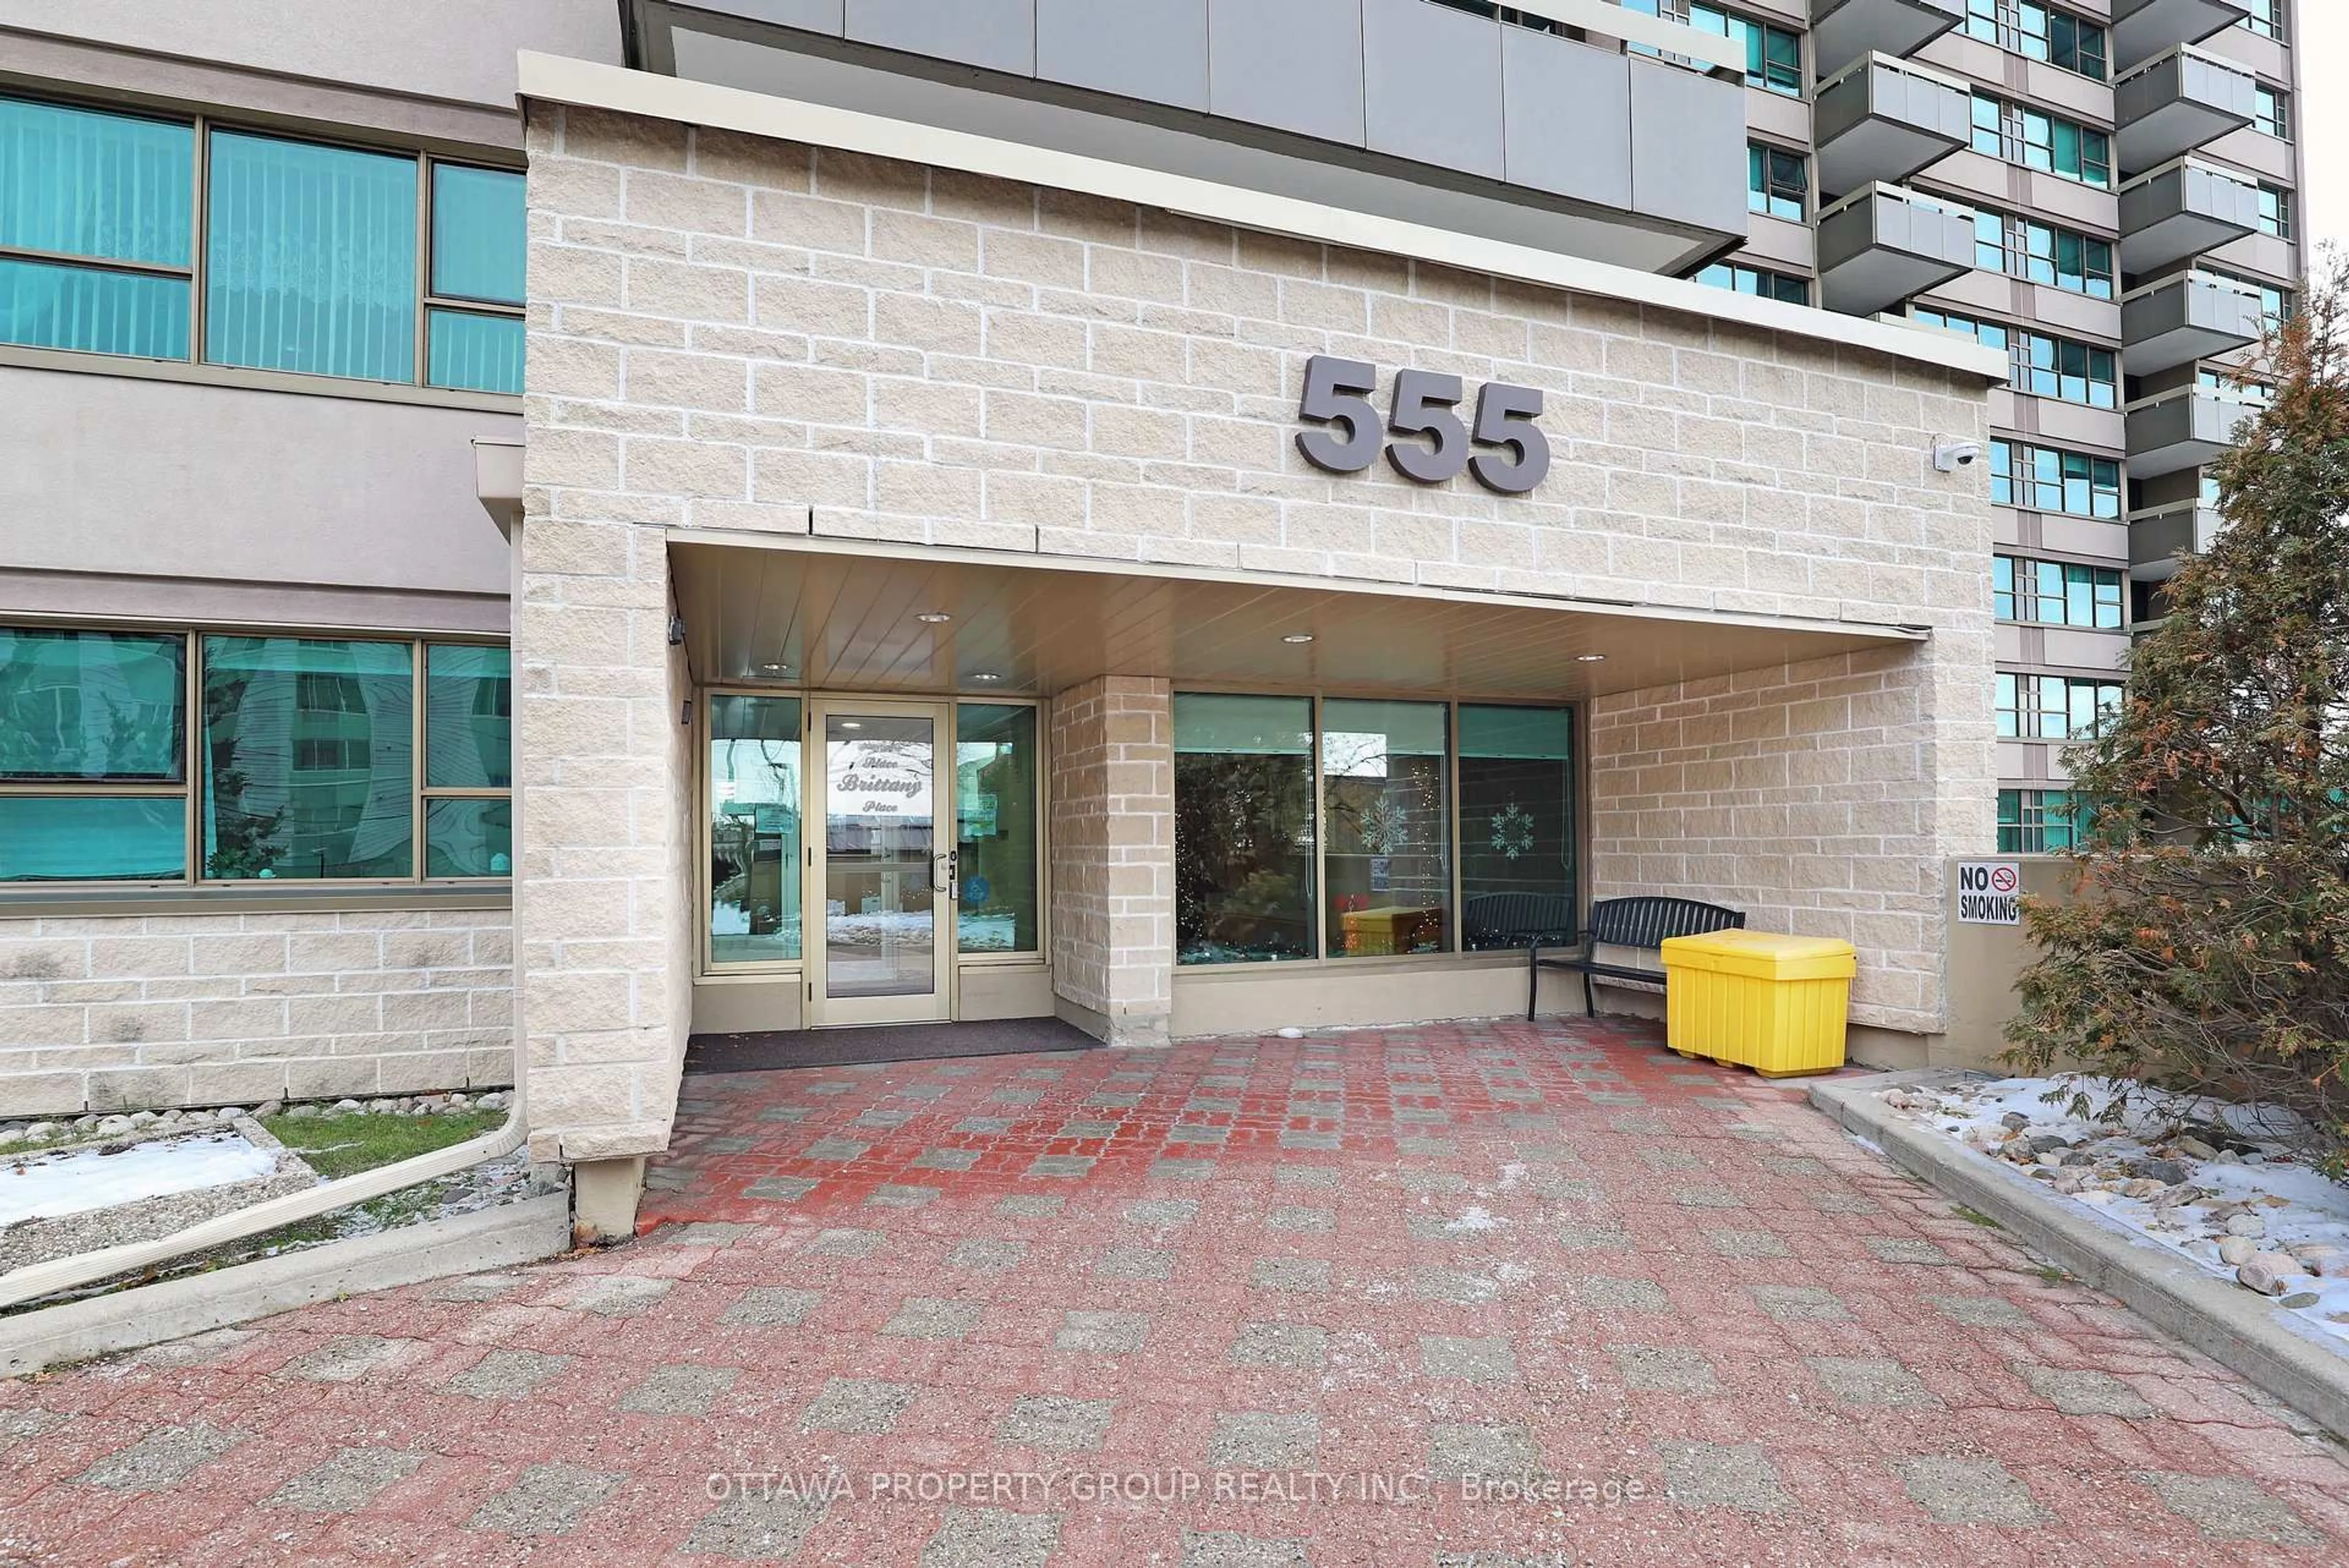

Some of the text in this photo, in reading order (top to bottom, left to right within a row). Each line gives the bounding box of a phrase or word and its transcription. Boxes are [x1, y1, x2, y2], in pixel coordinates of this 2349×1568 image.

[1294, 355, 1549, 494] 555
[836, 774, 922, 798] Brittany
[863, 801, 898, 812] Place
[1961, 867, 1988, 890] NO
[1961, 895, 2016, 921] SMOKING
